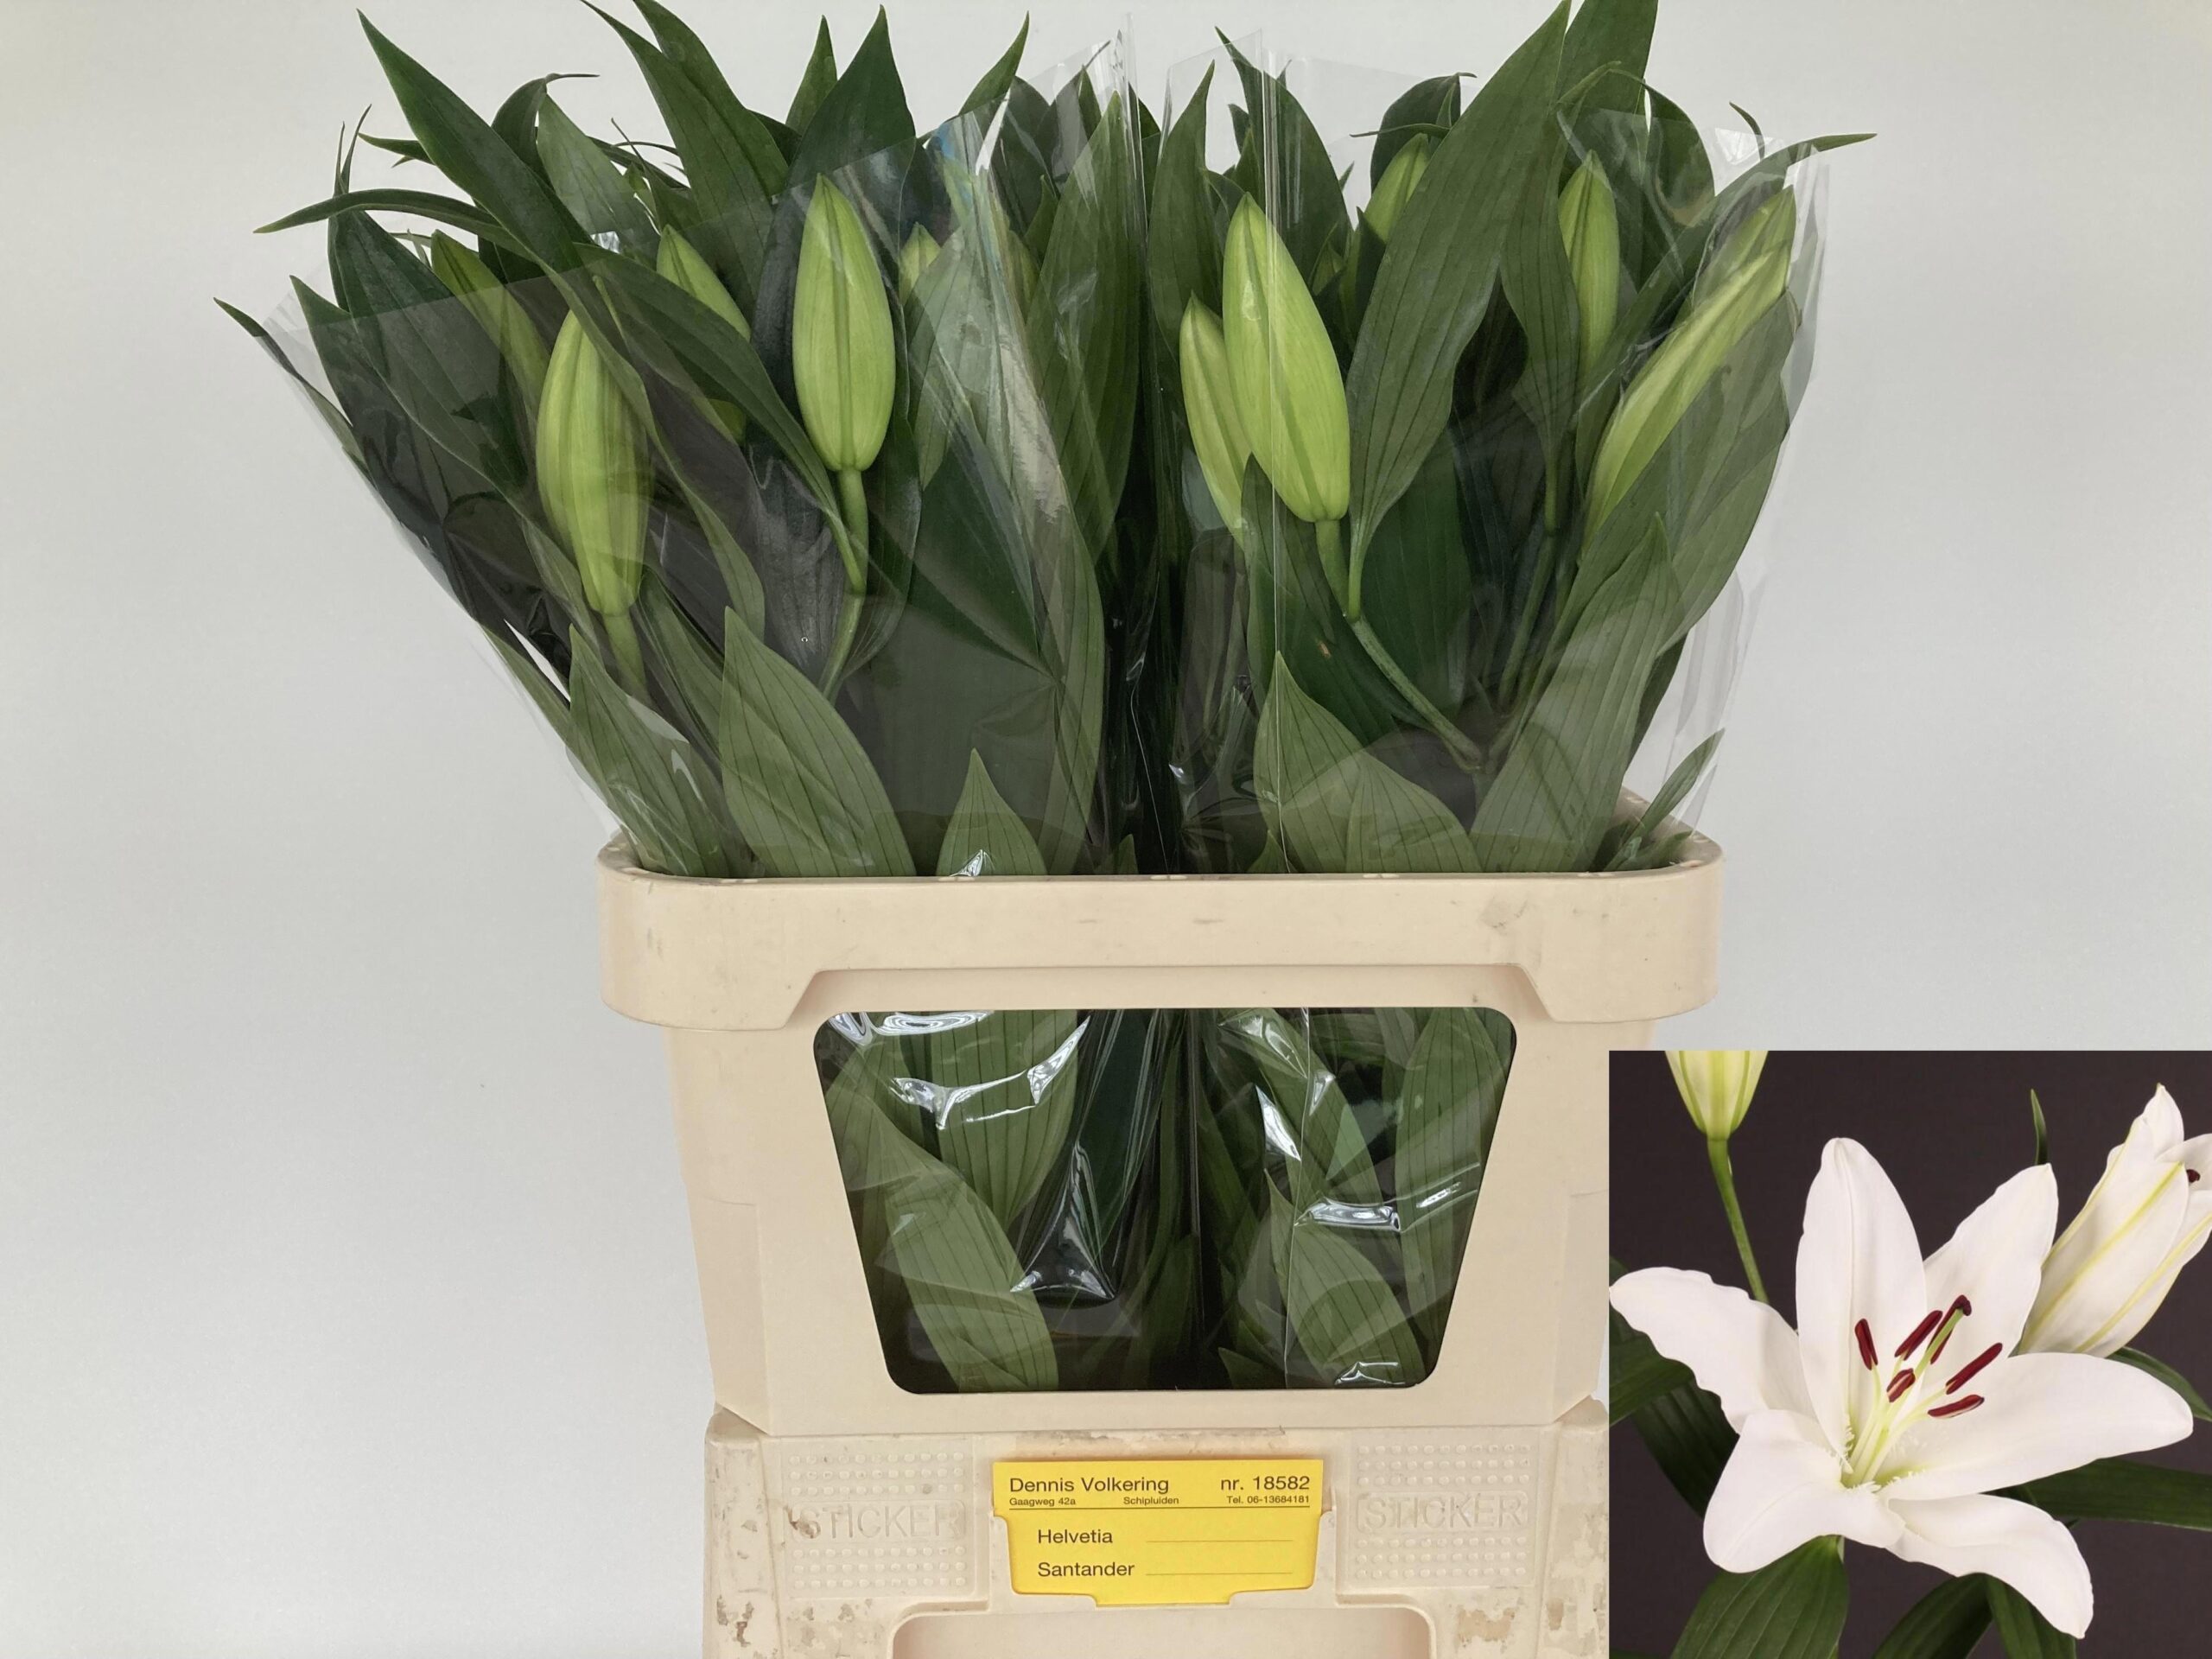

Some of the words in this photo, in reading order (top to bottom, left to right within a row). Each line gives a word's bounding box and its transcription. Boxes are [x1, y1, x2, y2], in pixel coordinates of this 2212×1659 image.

[1009, 1478, 1074, 1492] Dennis
[1082, 1477, 1169, 1495] Volkering
[1221, 1478, 1244, 1491] nr.
[1253, 1475, 1310, 1490] 18582
[1009, 1497, 1055, 1507] Gaagweg
[1123, 1496, 1179, 1506] Schipluiden
[1247, 1495, 1309, 1503] 06-13684181
[1365, 1494, 1522, 1529] STICKER
[797, 1503, 963, 1539] STICKER
[1038, 1529, 1113, 1544] Helvetia
[1038, 1561, 1135, 1577] Santander
